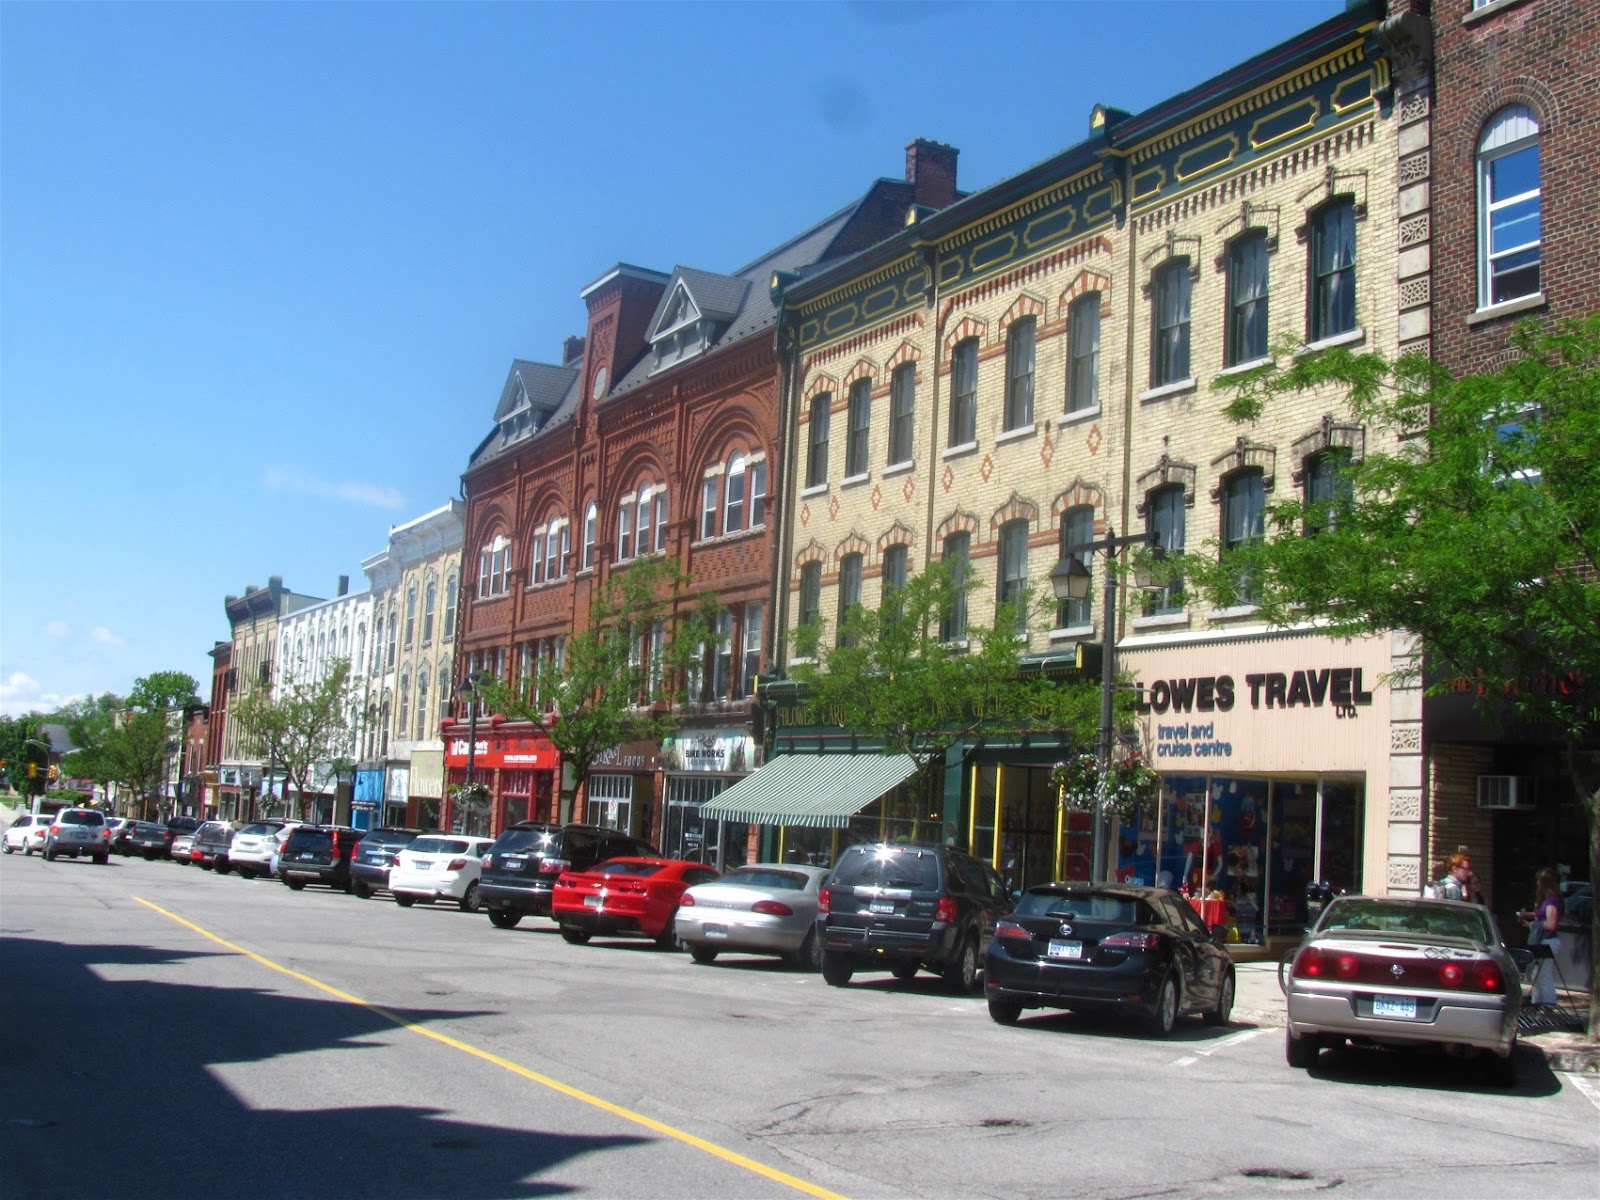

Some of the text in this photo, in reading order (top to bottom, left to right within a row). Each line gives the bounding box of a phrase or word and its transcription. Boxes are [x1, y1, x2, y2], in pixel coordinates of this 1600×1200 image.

[1126, 667, 1373, 715] LOWES TRAVEL
[1335, 704, 1359, 719] LTD.
[1157, 722, 1214, 740] travel and
[685, 749, 725, 758] BIKE WORKS
[1156, 740, 1232, 757] cruise centre
[623, 755, 646, 767] FOODS
